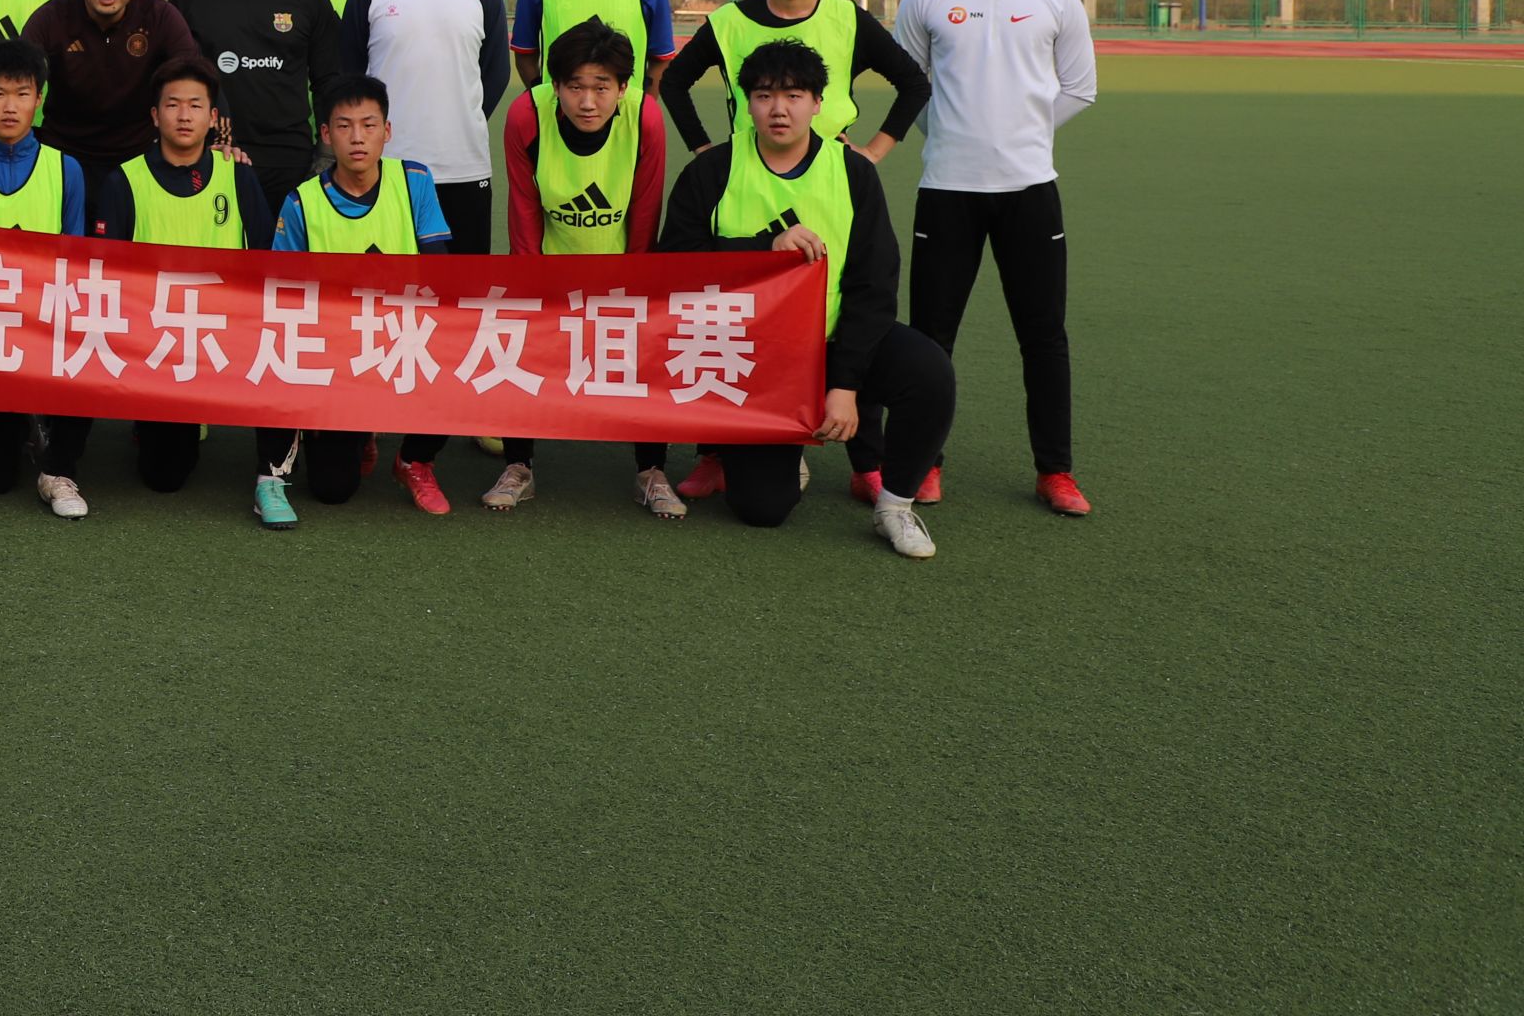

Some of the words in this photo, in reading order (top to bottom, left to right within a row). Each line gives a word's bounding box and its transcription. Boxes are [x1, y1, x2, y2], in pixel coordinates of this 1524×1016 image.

[241, 56, 284, 69] Spotify
[213, 193, 230, 226] 9
[549, 209, 623, 228] adidas
